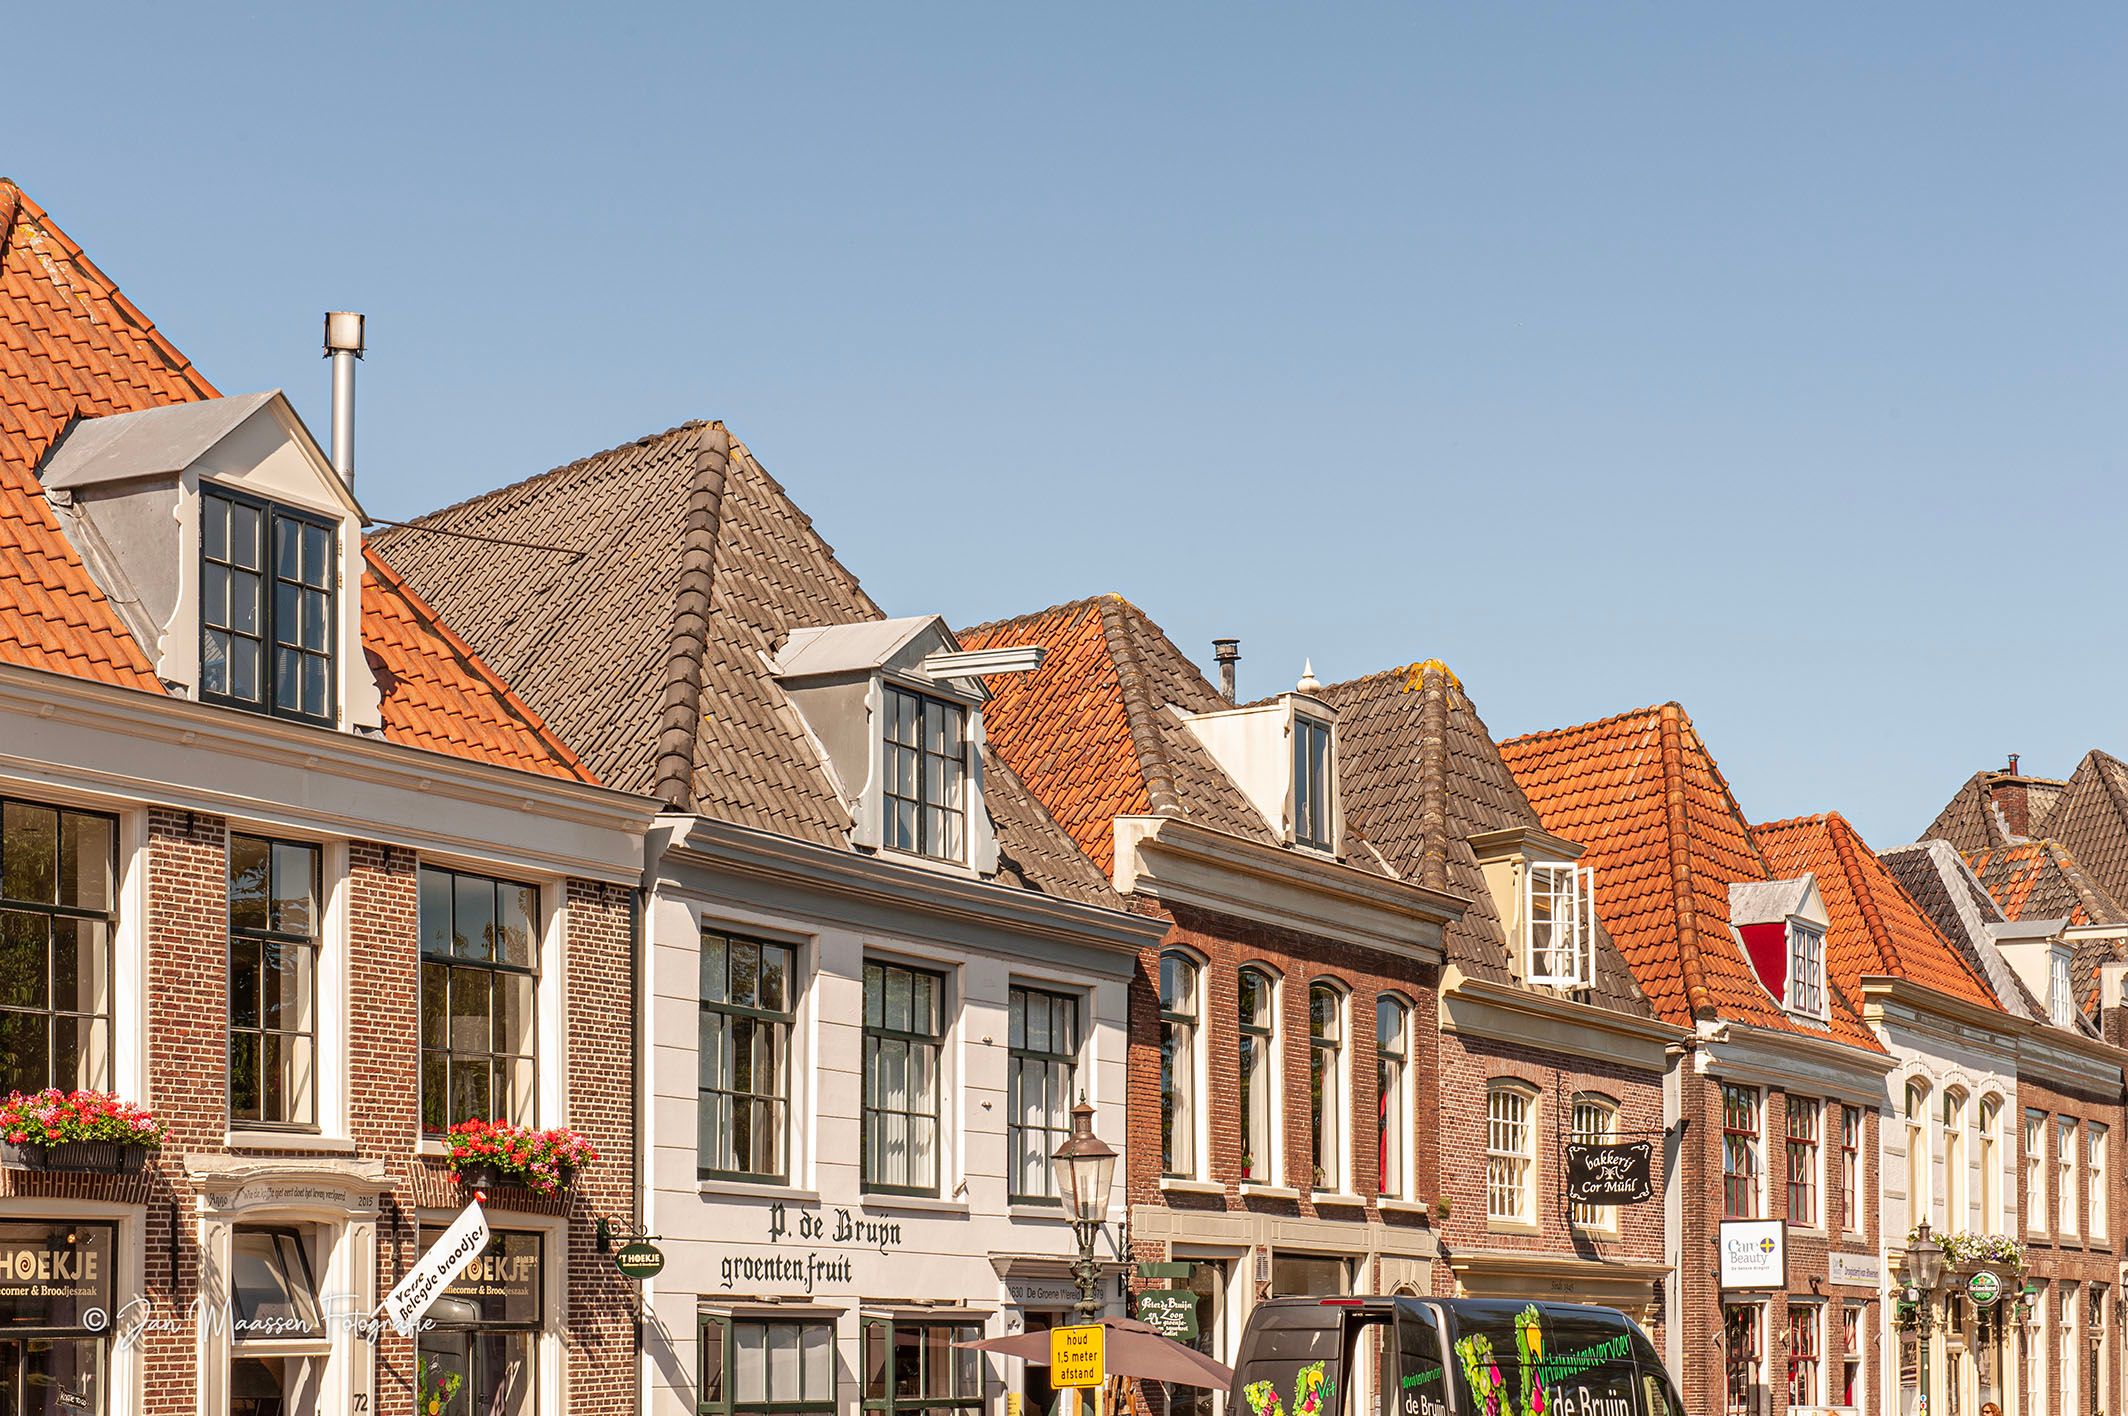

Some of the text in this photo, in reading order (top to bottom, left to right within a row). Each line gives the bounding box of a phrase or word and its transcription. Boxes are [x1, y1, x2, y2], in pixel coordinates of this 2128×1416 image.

[1585, 1150, 1636, 1172] bakkerij
[1582, 1178, 1638, 1193] Cor Mühl
[358, 1196, 373, 1207] 2015
[768, 1202, 792, 1243] P.
[799, 1204, 824, 1240] de
[1728, 1239, 1759, 1253] Care
[0, 1250, 97, 1280] HOEKJE
[628, 1254, 660, 1263] HOEKJE
[1729, 1252, 1769, 1265] Beauty
[399, 1225, 484, 1322] Belegde broodjes
[31, 1285, 39, 1296] &
[41, 1285, 97, 1298] Broodjeszaak
[394, 1272, 424, 1303] Verse
[479, 1285, 486, 1295] &
[1026, 1287, 1036, 1299] De
[1037, 1287, 1060, 1299] Groene
[1160, 1309, 1184, 1320] Zoon
[1067, 1333, 1088, 1345] houd
[1072, 1351, 1097, 1362] meter
[1061, 1367, 1094, 1379] afstand
[353, 1393, 368, 1412] 72
[1405, 1392, 1419, 1415] de
[1553, 1385, 1575, 1416] de
